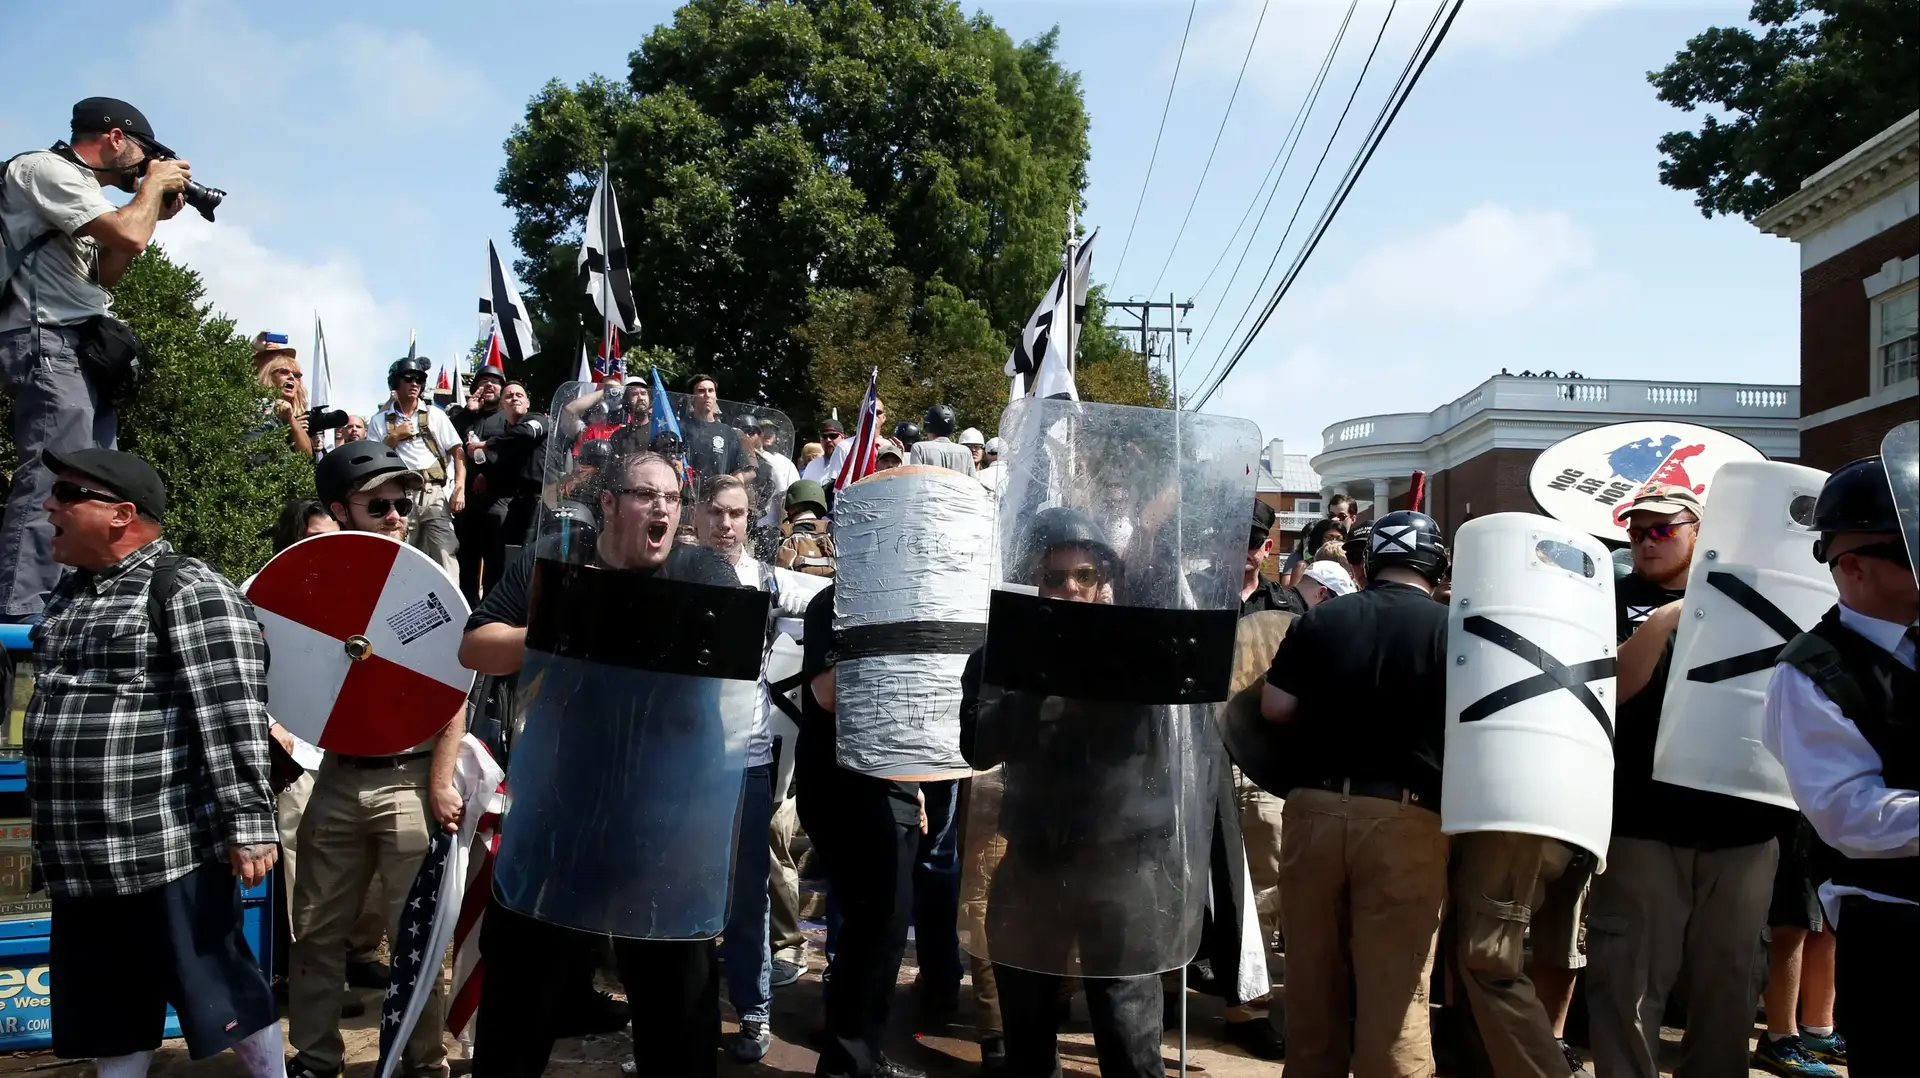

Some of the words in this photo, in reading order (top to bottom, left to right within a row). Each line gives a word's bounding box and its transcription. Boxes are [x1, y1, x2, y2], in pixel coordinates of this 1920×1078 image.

[1547, 468, 1585, 491] NOG
[1571, 478, 1606, 495] ÄR
[1594, 481, 1634, 506] NOG
